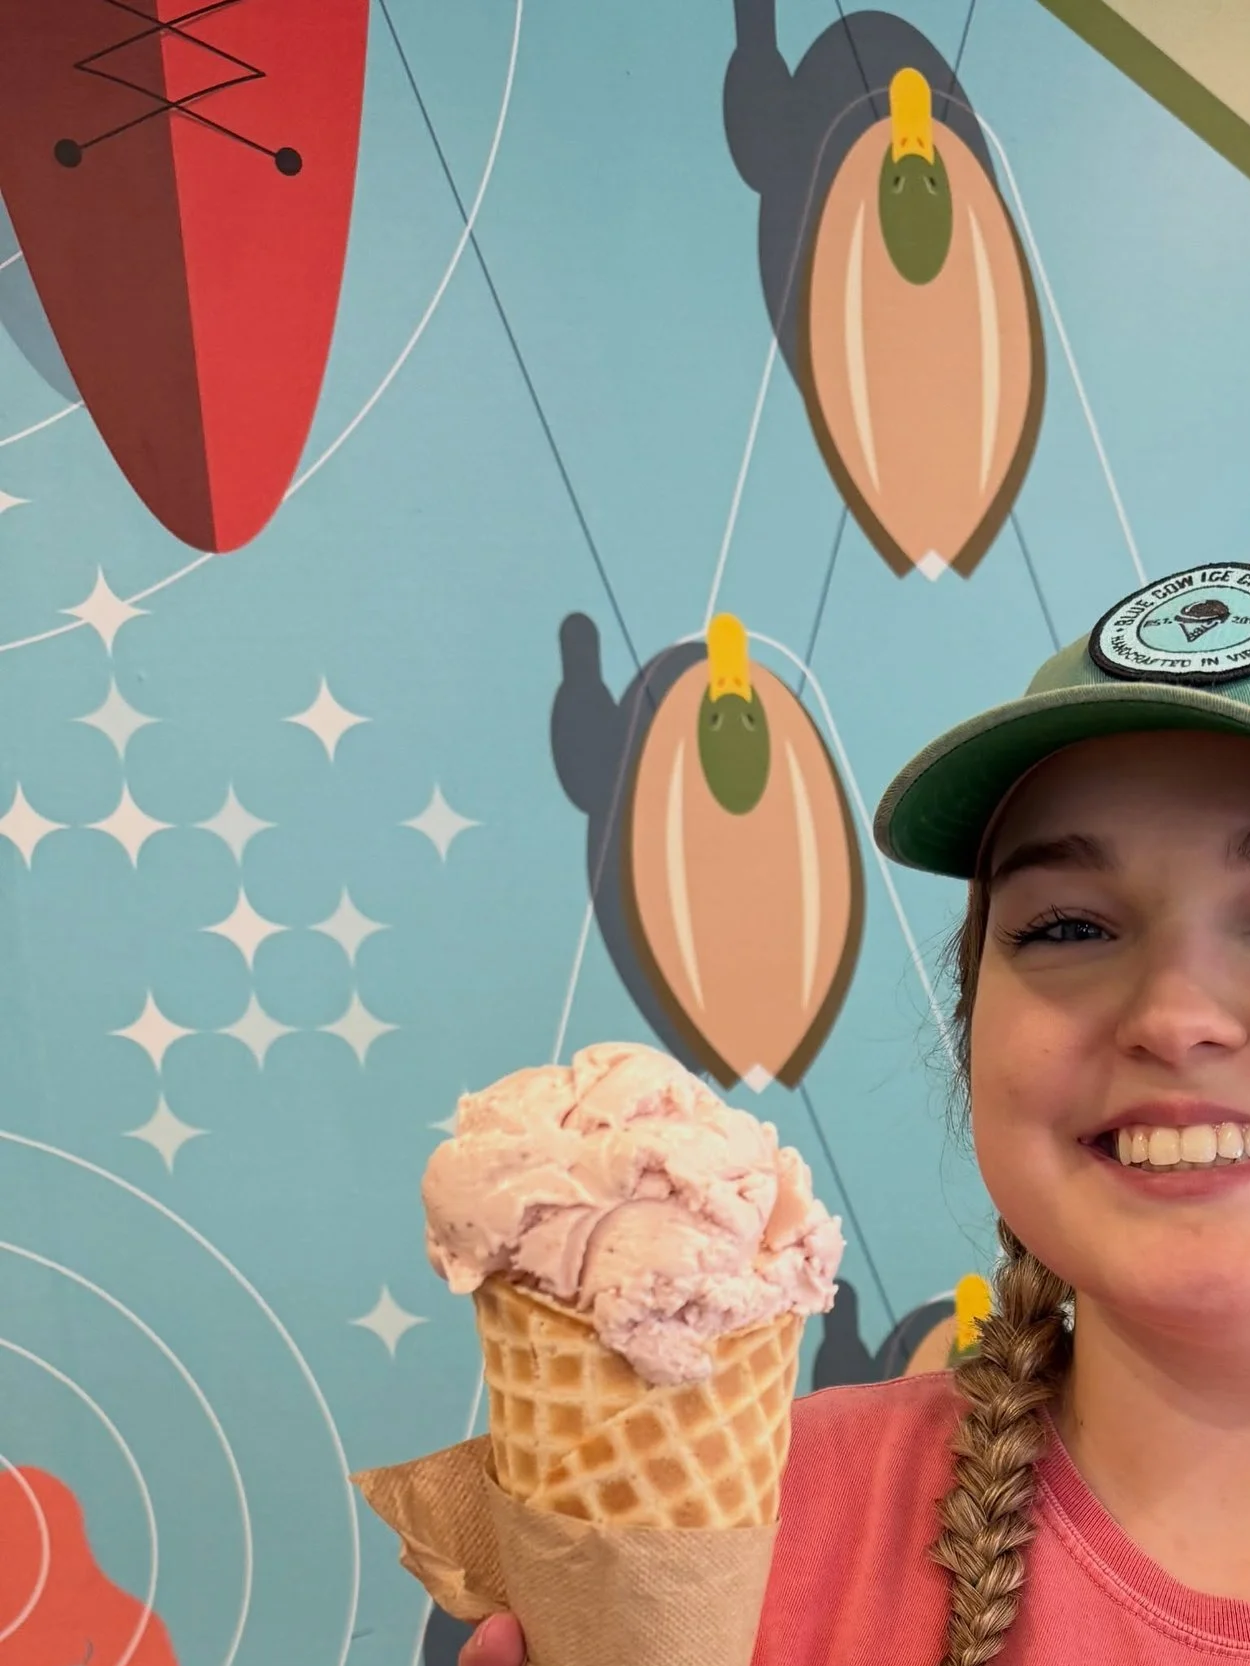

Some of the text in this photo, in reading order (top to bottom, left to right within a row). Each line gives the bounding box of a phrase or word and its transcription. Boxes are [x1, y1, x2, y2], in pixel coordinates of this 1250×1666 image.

[1113, 599, 1154, 626] BLUE
[1151, 575, 1194, 600] COW
[1200, 569, 1235, 583] ICE
[1111, 634, 1192, 668] HANDCRAFTED
[1200, 656, 1219, 667] IN
